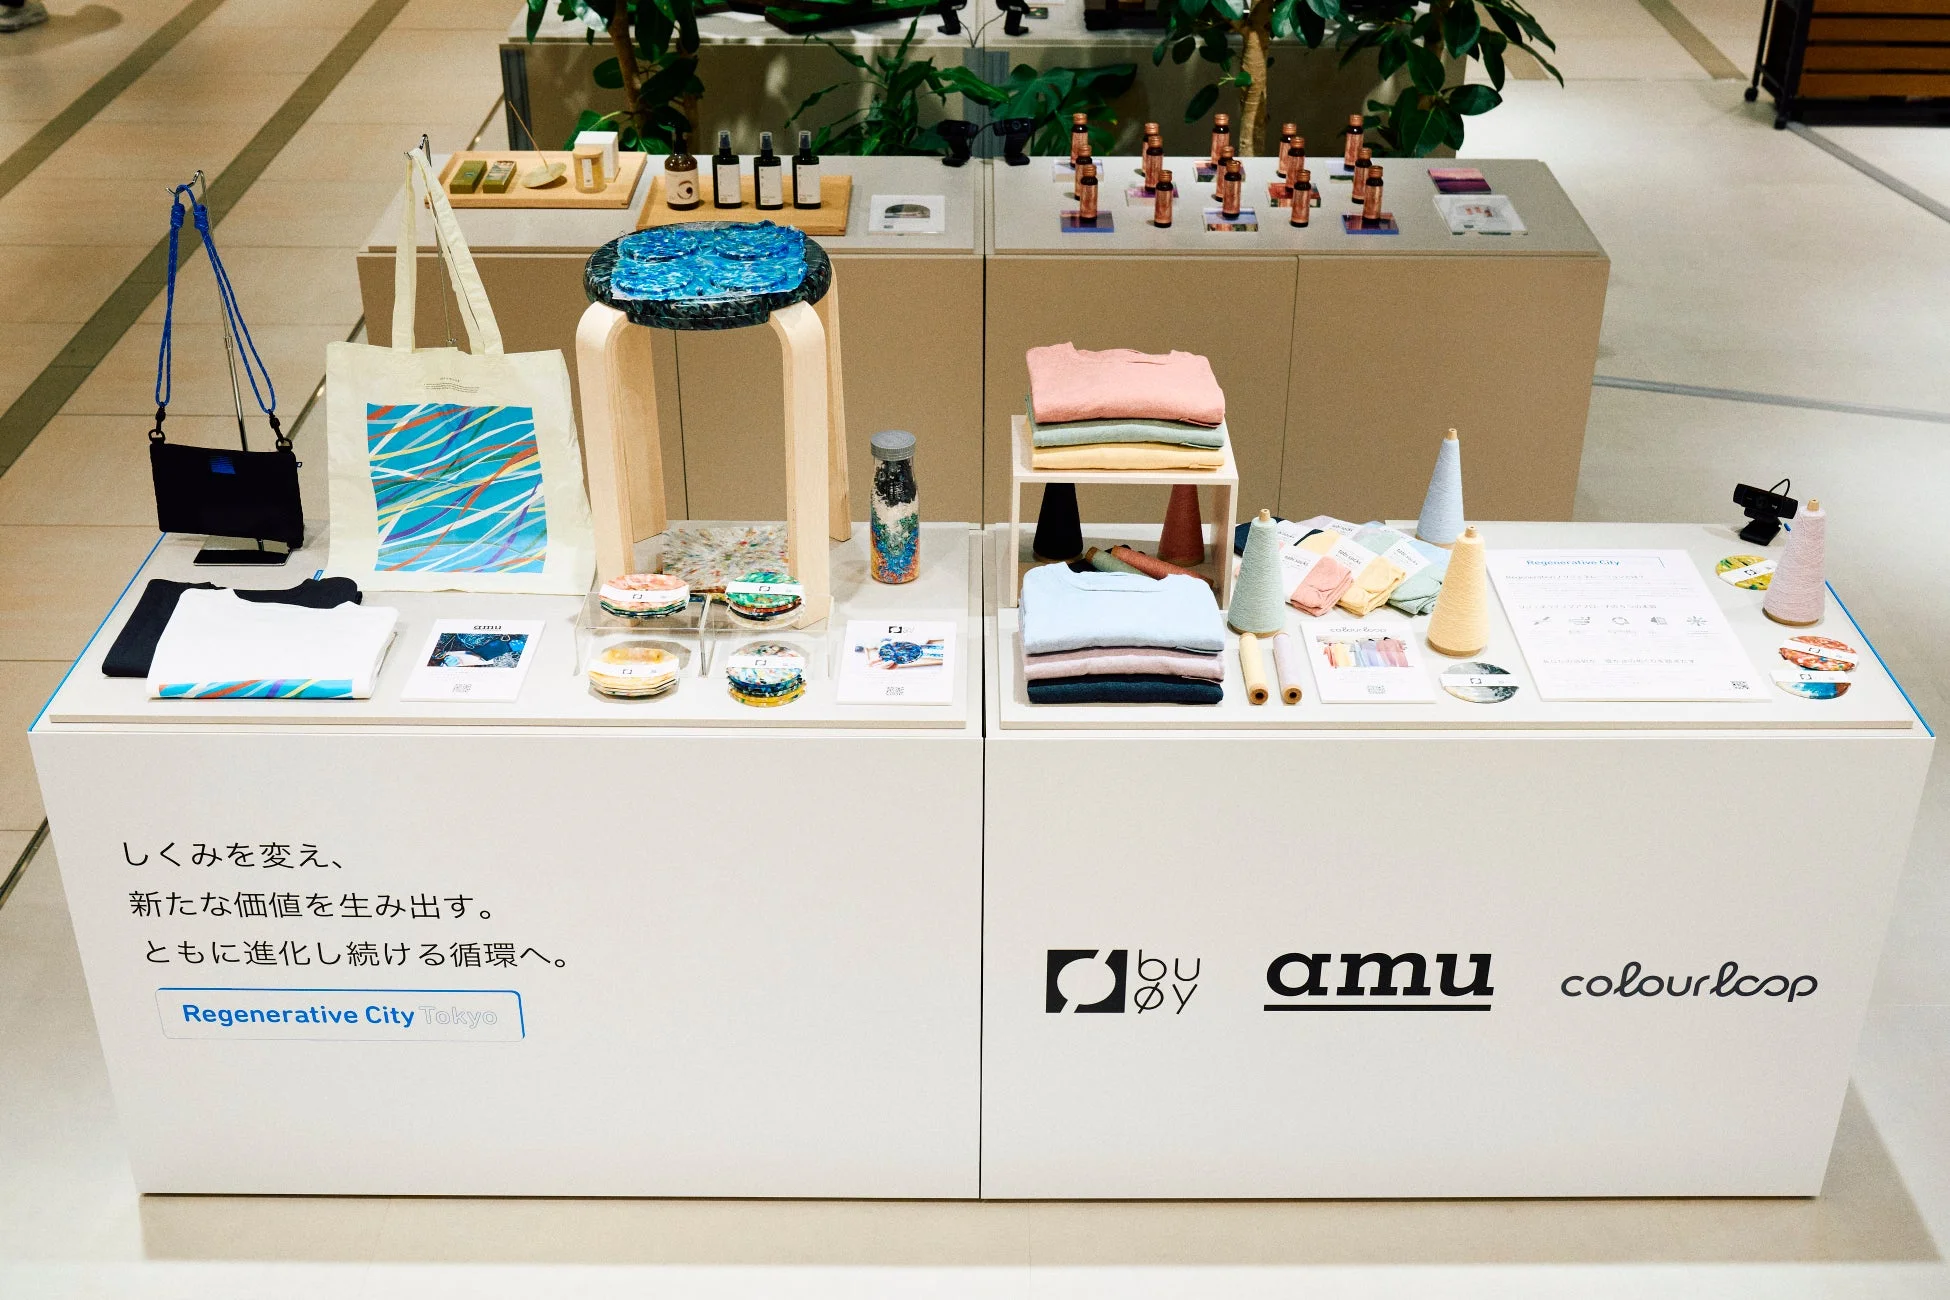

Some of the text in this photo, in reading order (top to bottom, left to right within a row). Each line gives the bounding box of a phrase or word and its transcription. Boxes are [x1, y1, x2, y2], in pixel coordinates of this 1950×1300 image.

[123, 842, 344, 869] しくみを変え、
[129, 891, 492, 919] 新たな価値を生み出す。
[146, 940, 568, 969] ともに進化し続ける循環へ。
[1266, 952, 1495, 997] amu
[1561, 960, 1819, 1003] colourloop
[182, 1004, 498, 1030] Regenerative City Tokyo
